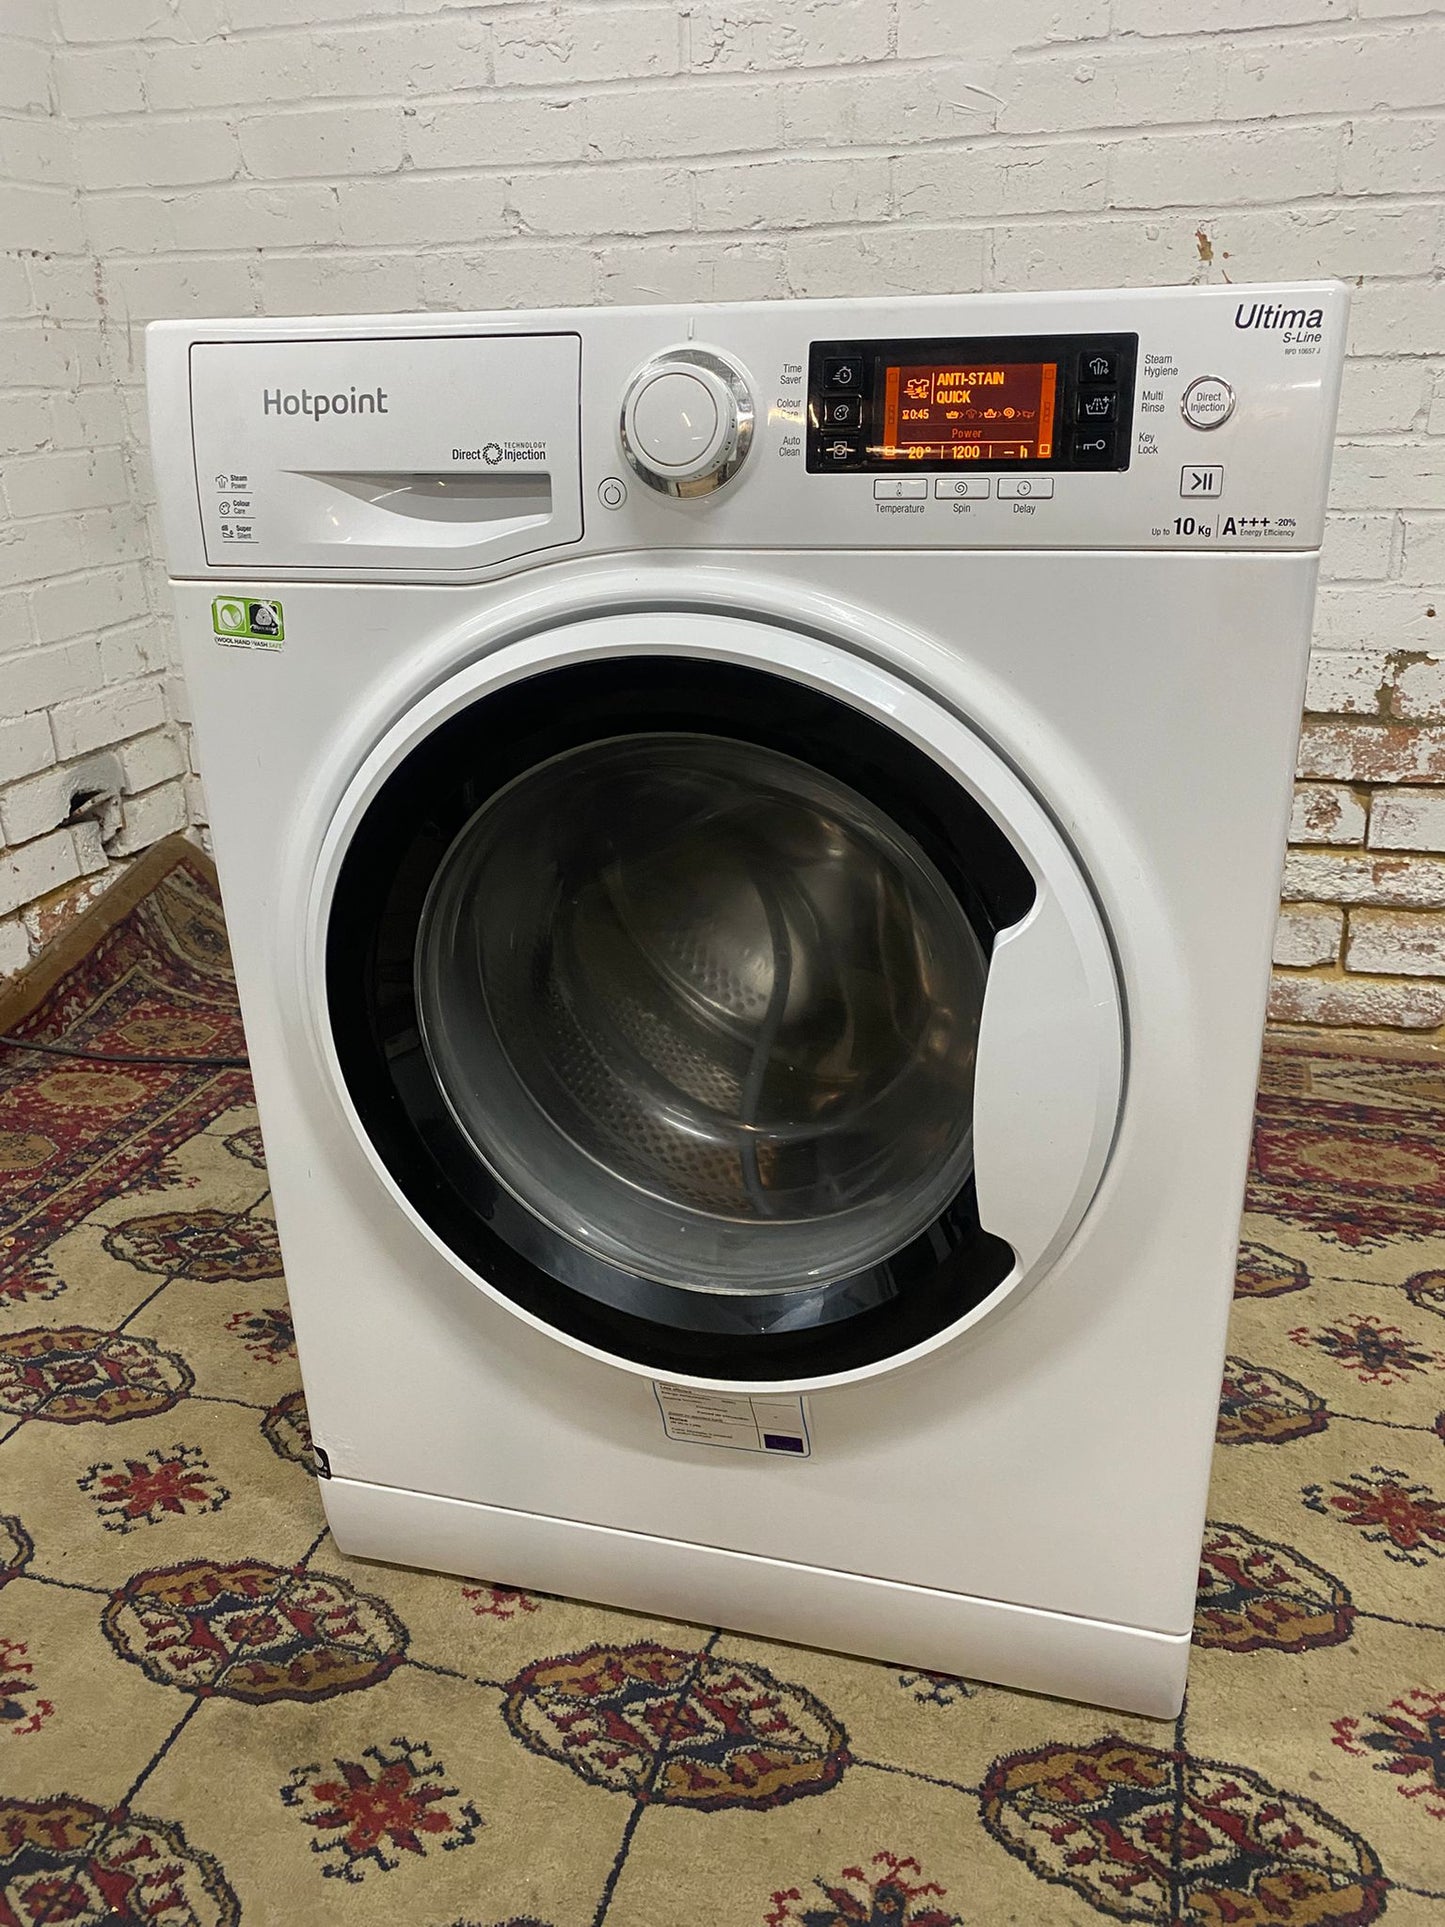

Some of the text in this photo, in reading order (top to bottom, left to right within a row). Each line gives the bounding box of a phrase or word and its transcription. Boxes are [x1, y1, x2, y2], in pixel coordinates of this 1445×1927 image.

[1235, 303, 1323, 329] Ultima
[1283, 331, 1322, 343] S-Line
[1145, 354, 1173, 364] Steam
[783, 363, 802, 373] Time
[1144, 366, 1178, 376] Hygiene
[780, 375, 802, 385] Saver
[937, 372, 1005, 386] ANTI-STAIN
[936, 391, 971, 404] QUICK
[1142, 391, 1164, 401] Multi
[1196, 392, 1222, 402] Direct
[263, 387, 389, 421] Hotpoint
[776, 398, 801, 408] Colour
[1141, 403, 1165, 413] Rinse
[1190, 403, 1226, 413] Injection
[910, 409, 930, 420] 0:45
[951, 428, 982, 439] Power
[1139, 432, 1155, 443] Key
[504, 441, 546, 449] TECHNOLOGY
[782, 436, 801, 446] Auto
[779, 447, 801, 457] Clean
[952, 445, 980, 458] 1200
[1138, 445, 1158, 454] Lock
[452, 449, 546, 462] Direct Injection
[875, 504, 925, 514] Temperature
[952, 504, 971, 514] Spin
[1013, 503, 1036, 514] Delay
[1151, 528, 1161, 536] Up
[1174, 518, 1195, 535] 10
[1198, 525, 1211, 537] Kg
[1222, 517, 1296, 535] A+++ -20%
[1240, 528, 1295, 537] Energy Efficiency
